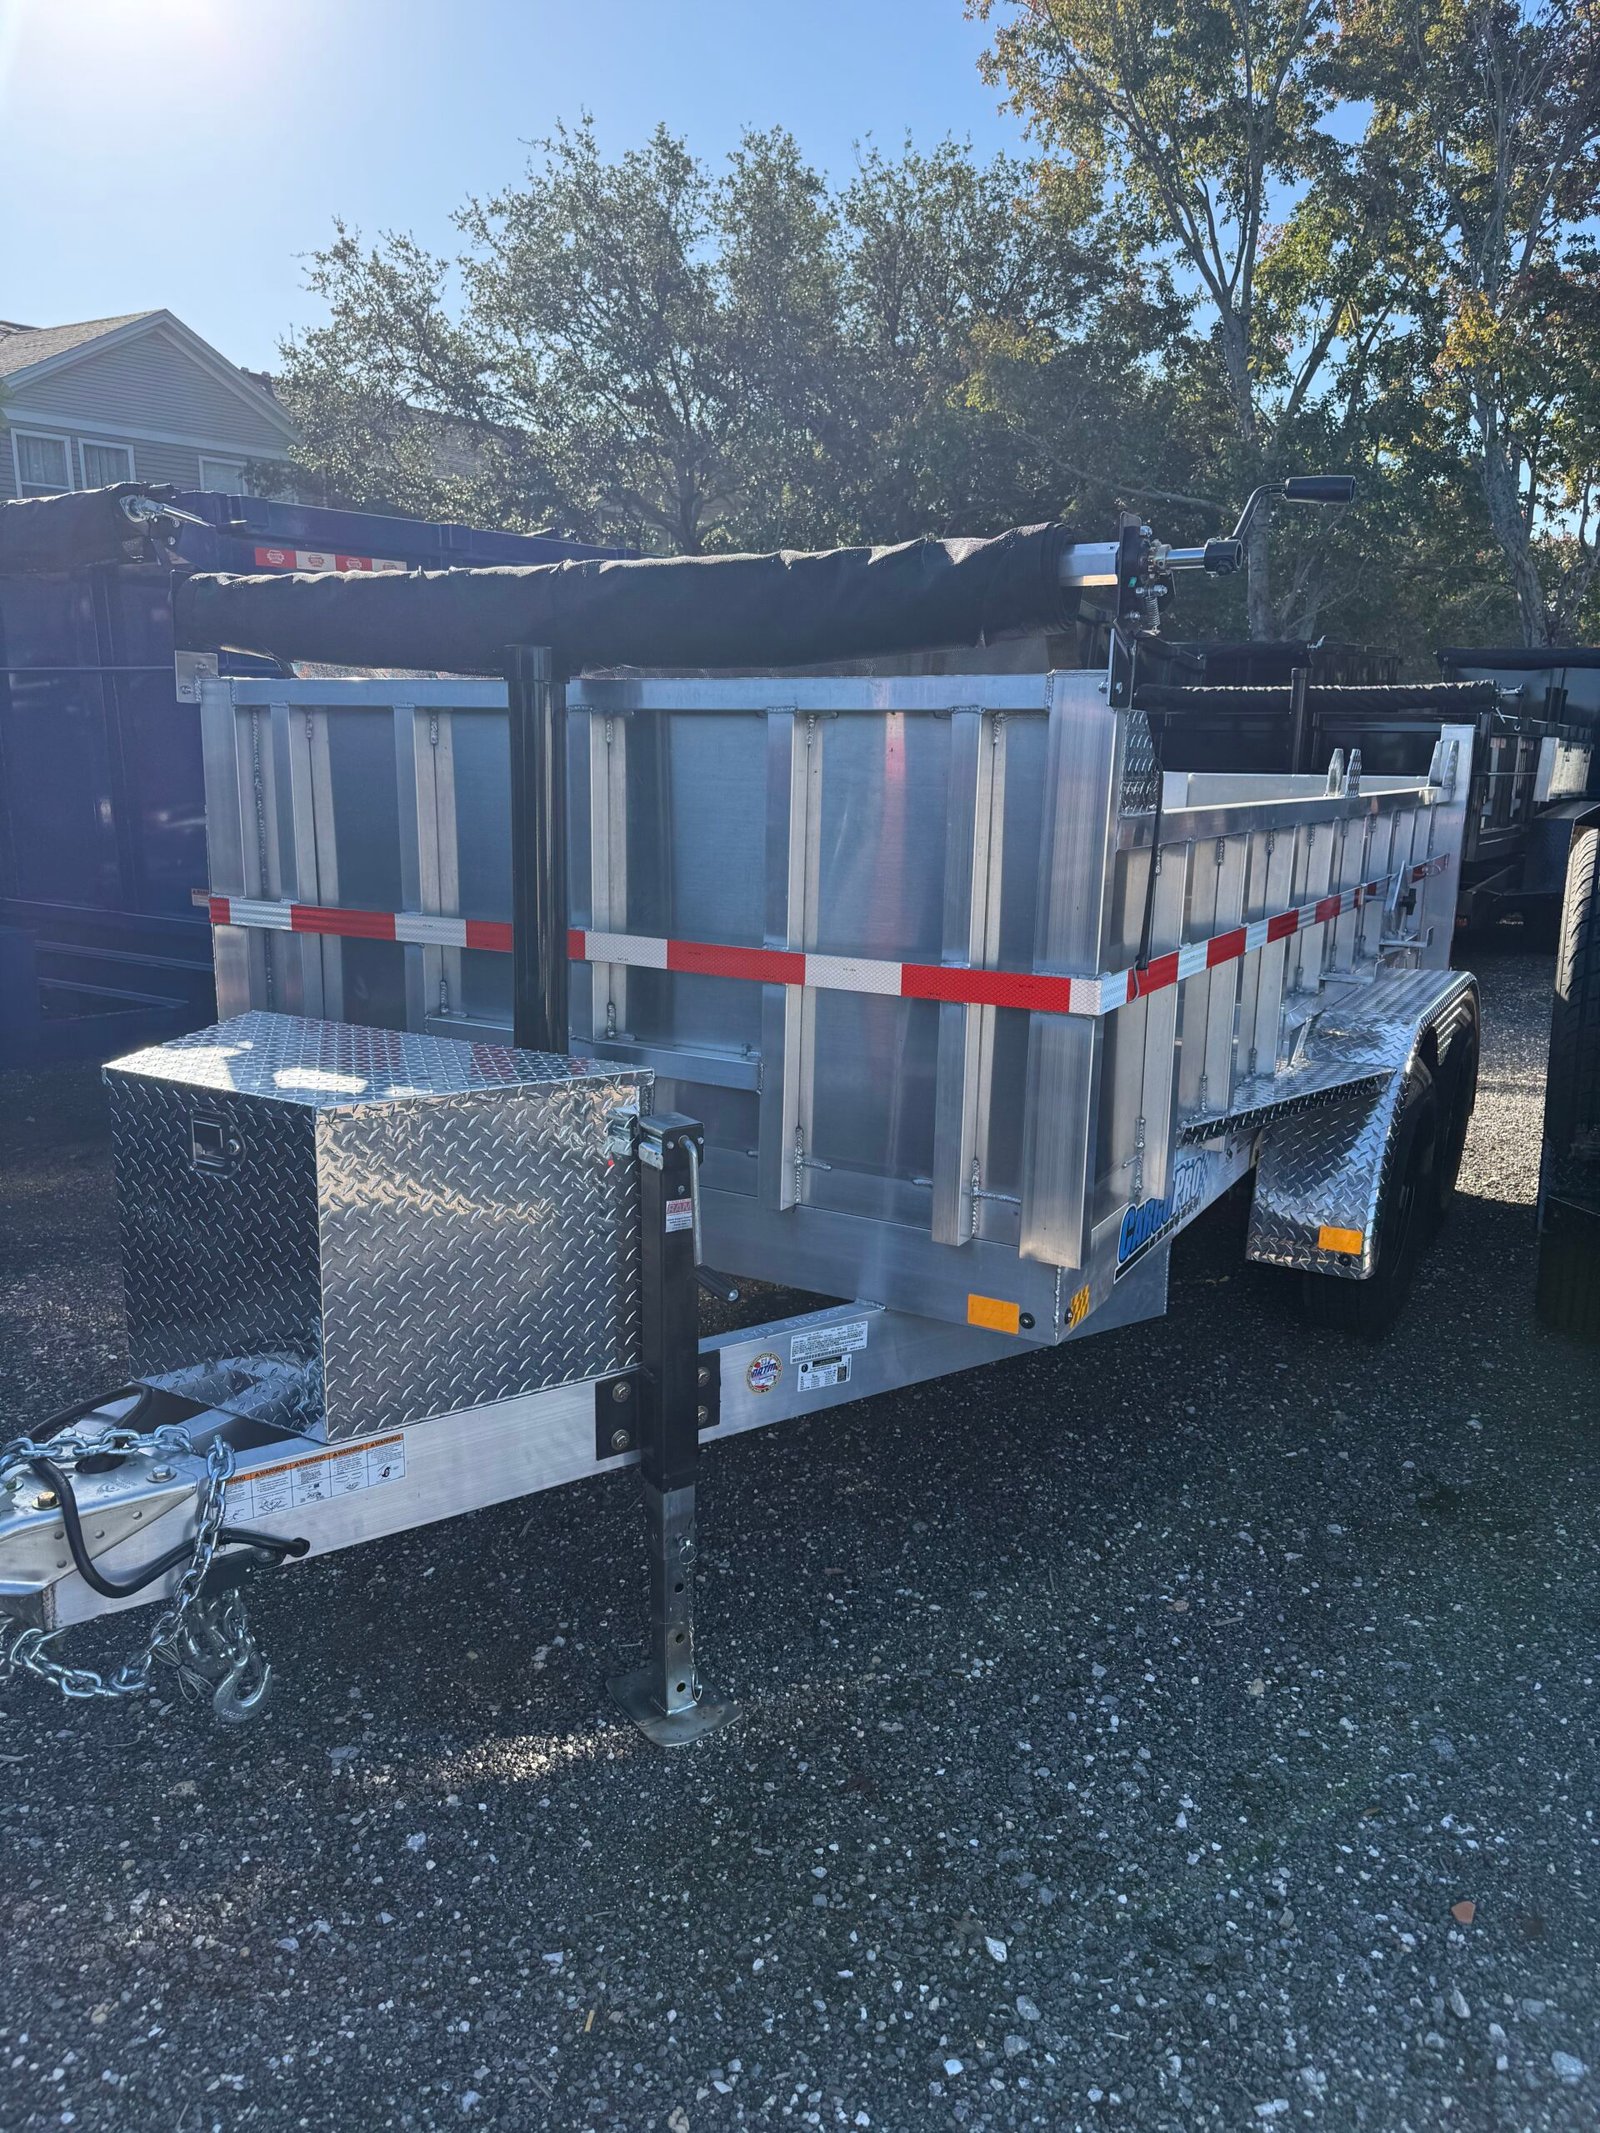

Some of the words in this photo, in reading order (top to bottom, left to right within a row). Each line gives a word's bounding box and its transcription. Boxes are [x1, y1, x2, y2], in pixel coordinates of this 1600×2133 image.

[1172, 1157, 1203, 1214] PRO
[667, 1202, 692, 1213] RAM
[375, 1436, 401, 1446] WARNING
[337, 1445, 364, 1455] WARNING
[300, 1456, 326, 1465] WARNING
[260, 1466, 288, 1475] WARNING
